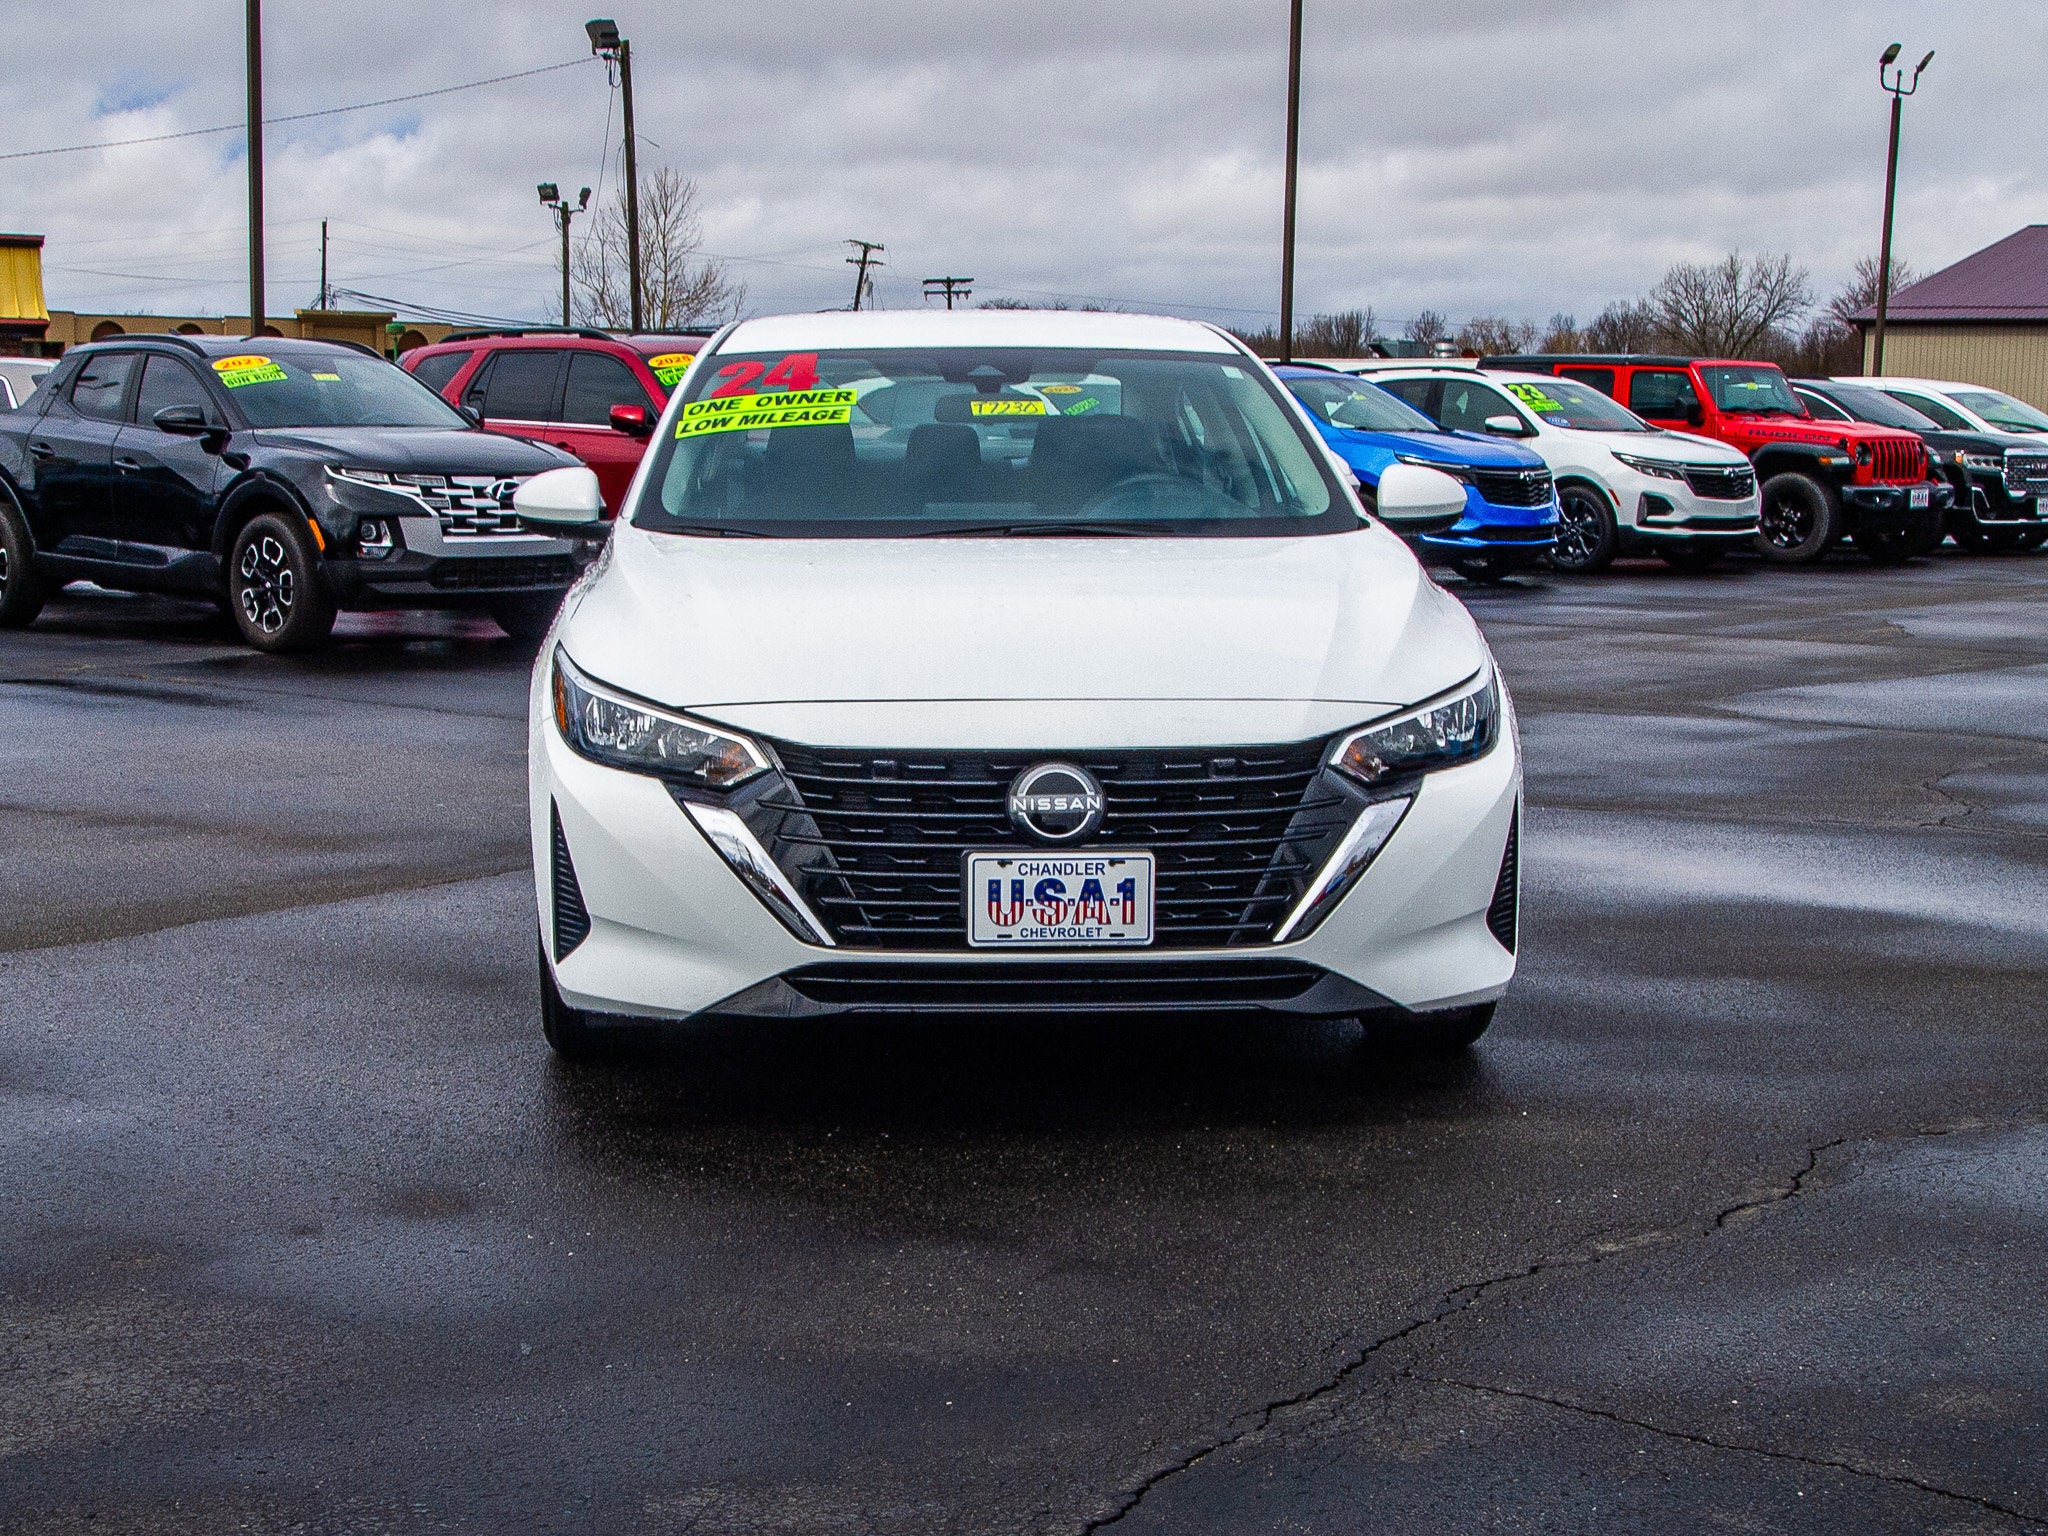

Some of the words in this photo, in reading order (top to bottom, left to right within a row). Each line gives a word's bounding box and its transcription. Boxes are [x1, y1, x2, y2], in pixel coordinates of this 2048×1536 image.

[710, 352, 820, 398] 24
[1507, 384, 1546, 401] 23
[688, 397, 743, 416] ONE
[756, 391, 852, 408] OWNER
[680, 416, 733, 434] LOW
[738, 409, 846, 426] MILEAGE
[1011, 796, 1101, 812] NISSAN
[1017, 862, 1106, 876] CHANDLER
[1020, 927, 1102, 938] CHEVROLET
